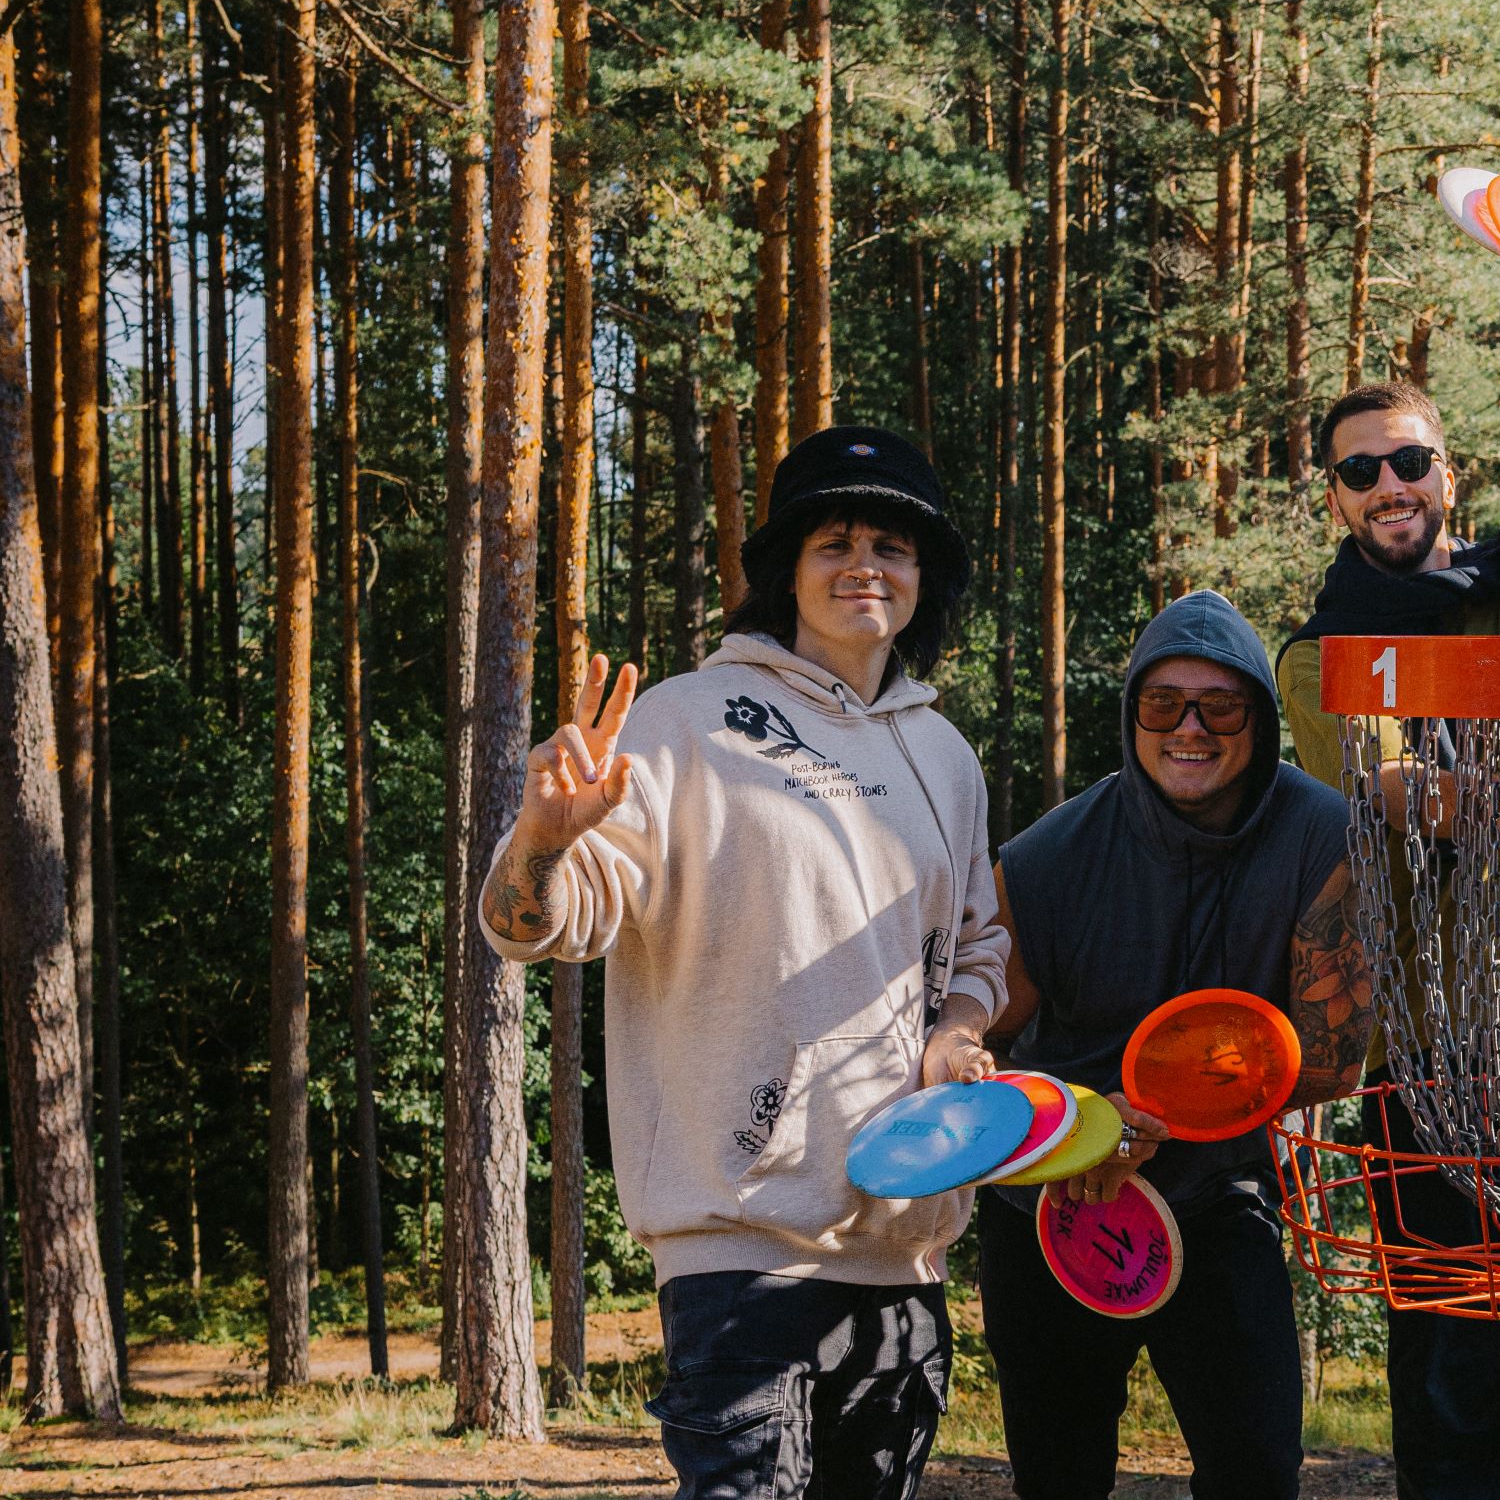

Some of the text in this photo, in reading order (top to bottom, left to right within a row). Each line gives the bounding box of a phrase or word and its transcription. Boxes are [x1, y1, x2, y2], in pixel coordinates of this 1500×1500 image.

[1372, 647, 1396, 708] 1
[832, 773, 858, 782] HEROES
[804, 785, 888, 801] AND CRAZY STONES
